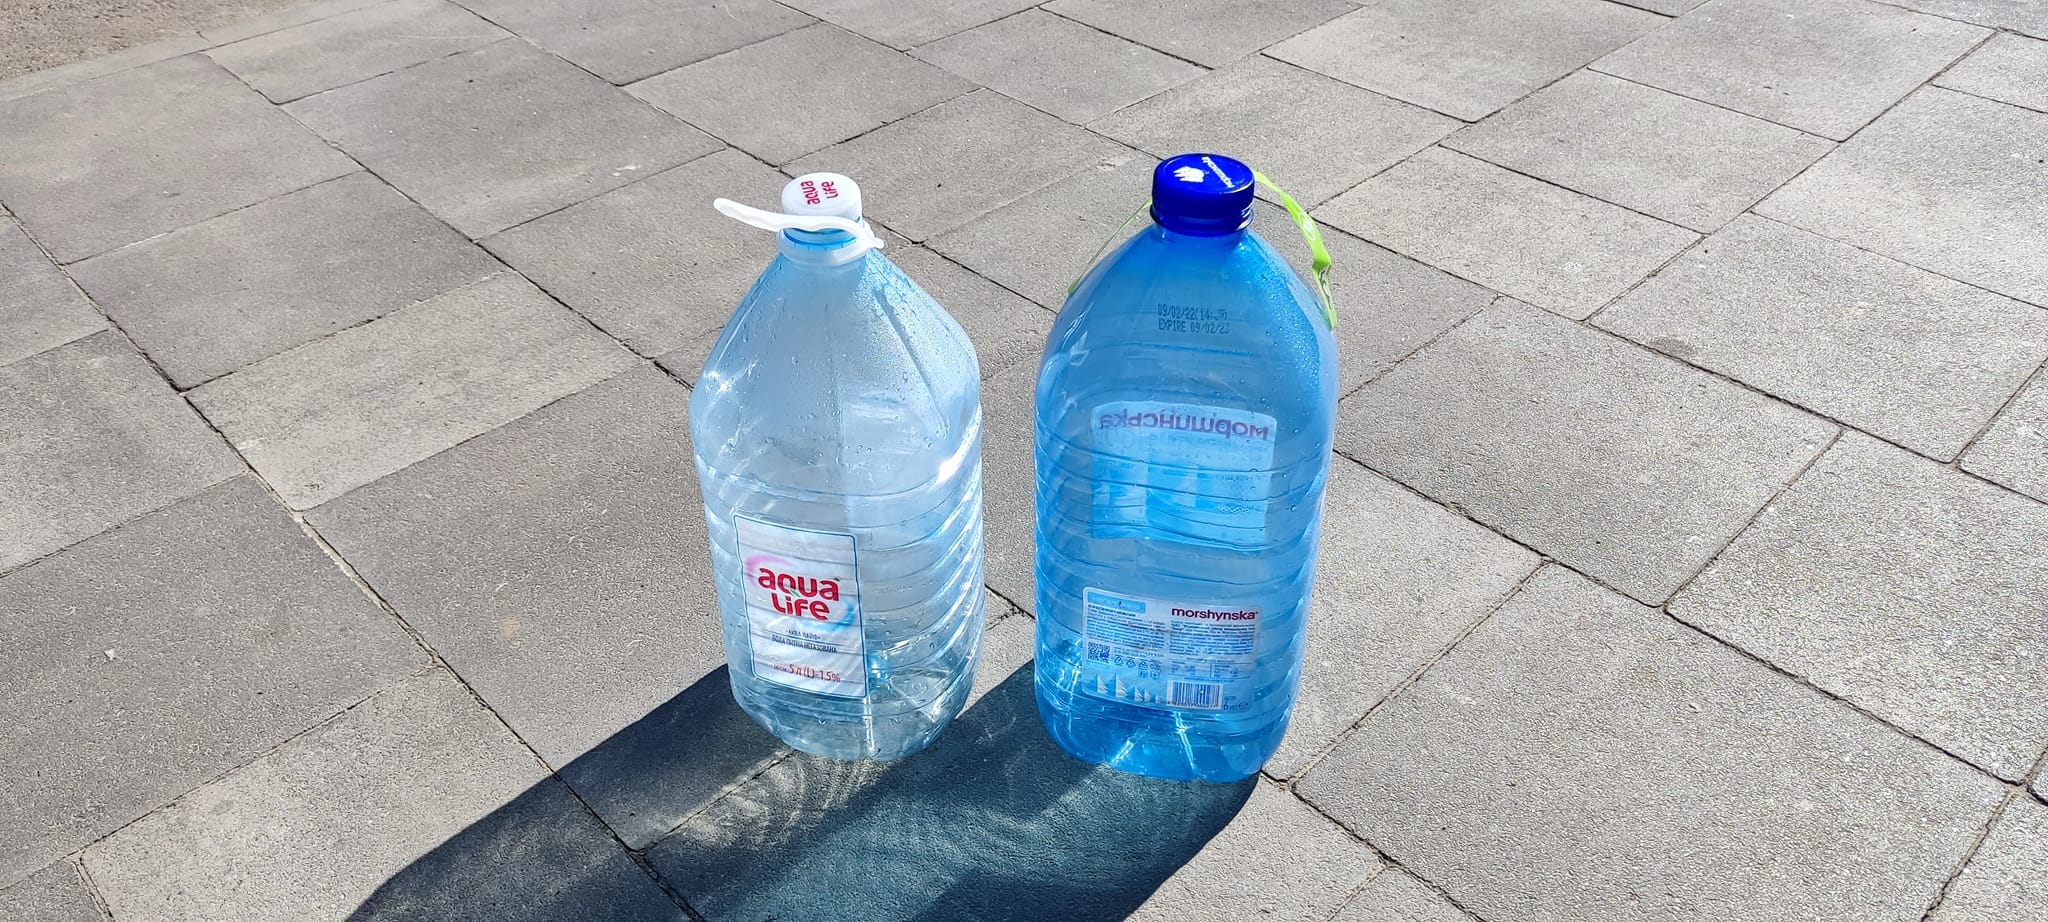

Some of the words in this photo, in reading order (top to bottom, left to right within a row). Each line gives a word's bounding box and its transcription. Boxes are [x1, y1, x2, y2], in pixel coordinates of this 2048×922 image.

[800, 181, 821, 205] aqua
[1158, 318, 1187, 333] EXPIRE
[757, 567, 840, 602] aqua
[1171, 607, 1256, 622] morshynska
